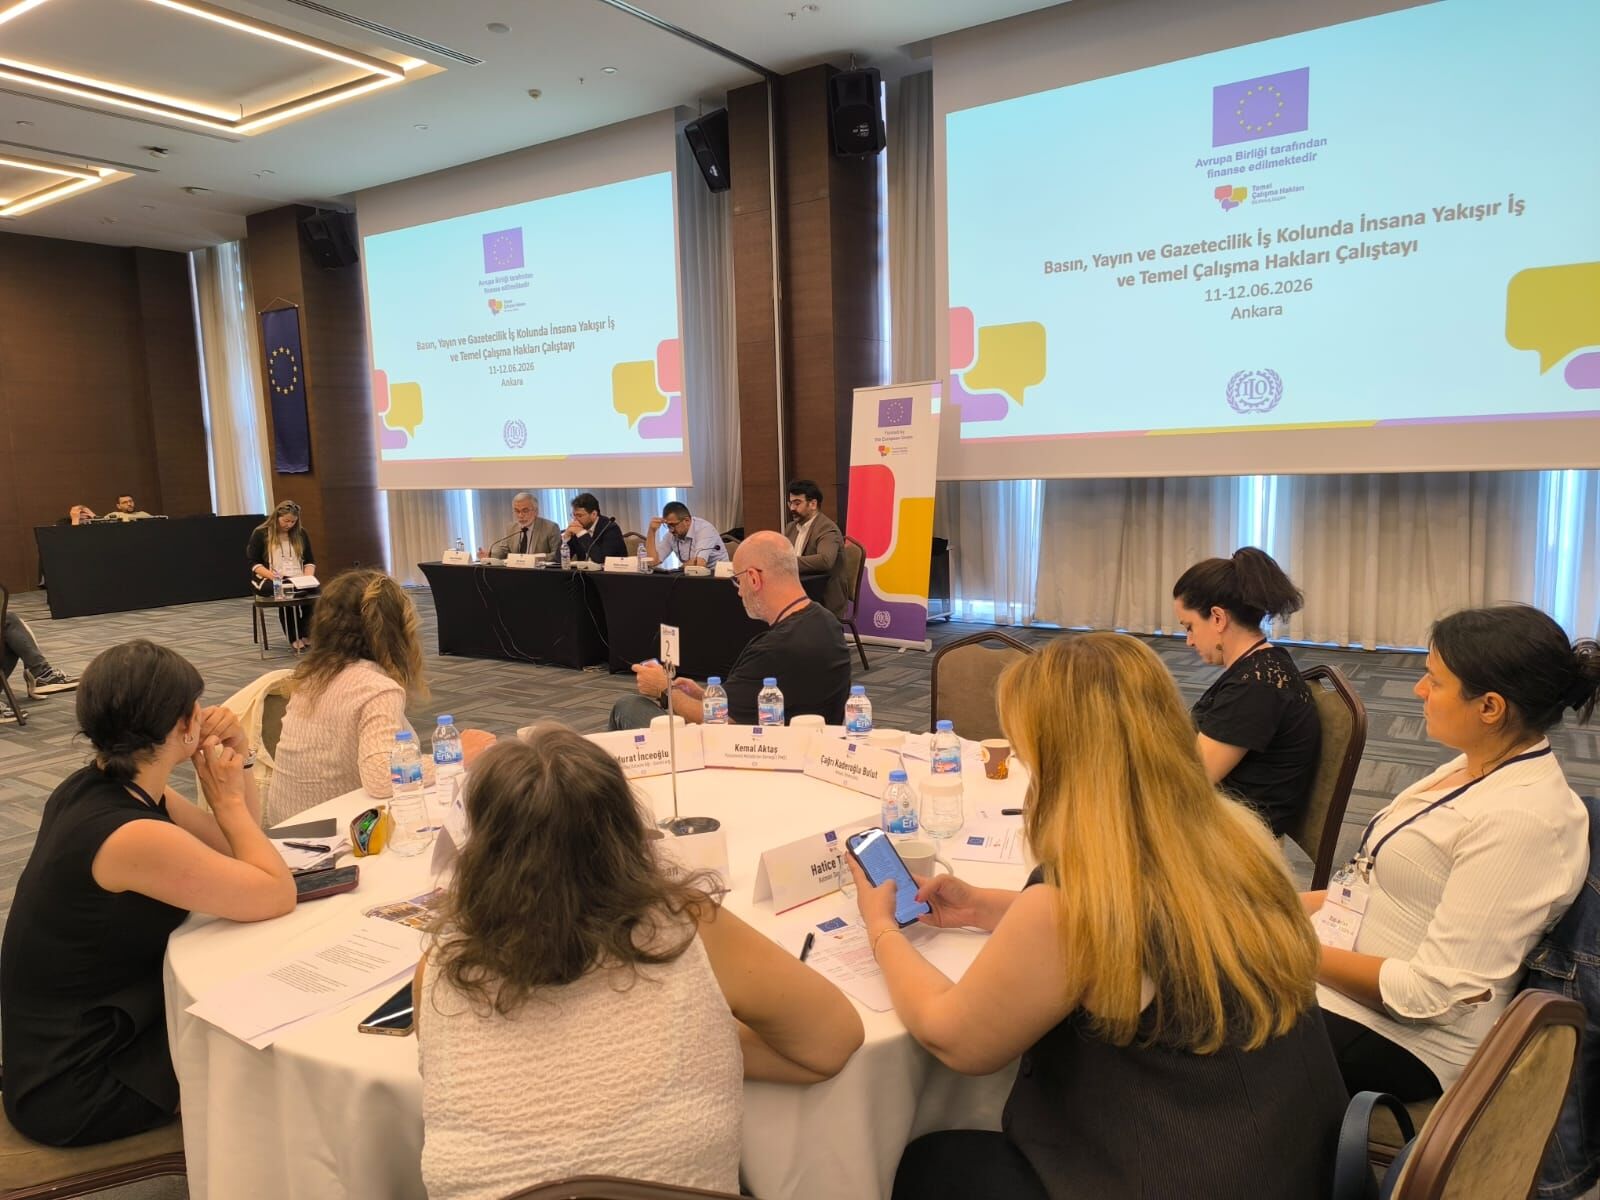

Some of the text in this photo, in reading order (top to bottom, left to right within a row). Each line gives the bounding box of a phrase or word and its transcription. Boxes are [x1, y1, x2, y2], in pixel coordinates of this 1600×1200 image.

[1195, 138, 1328, 168] Avrupa Birliği tarafından
[1207, 152, 1318, 179] finanse edilmektedir
[1044, 193, 1526, 274] Basın, Yayın ve Gazetecilik İş Kolunda İnsana Yakışır İş
[1117, 239, 1418, 288] ve Temel Çalışma Hakları Çalıştayı
[1204, 277, 1313, 302] 11-12.06.2026
[1230, 305, 1283, 320] Ankara
[416, 316, 616, 351] Basın, Yayın ve Gazetecilik İş Kolunda İnsana Yakışır İş
[450, 340, 576, 362] ve Temel Çalışma Hakları Çalıştayı
[488, 362, 535, 375] 11-12.06.2026
[501, 378, 524, 387] Ankara
[1243, 378, 1267, 400] ILO
[665, 640, 671, 658] 2
[638, 749, 669, 762] İnceoğlu
[735, 743, 778, 754] Kemal Aktaş
[835, 759, 861, 774] Kaderoğlu
[862, 767, 878, 779] Bulut
[810, 859, 837, 876] Hatice
